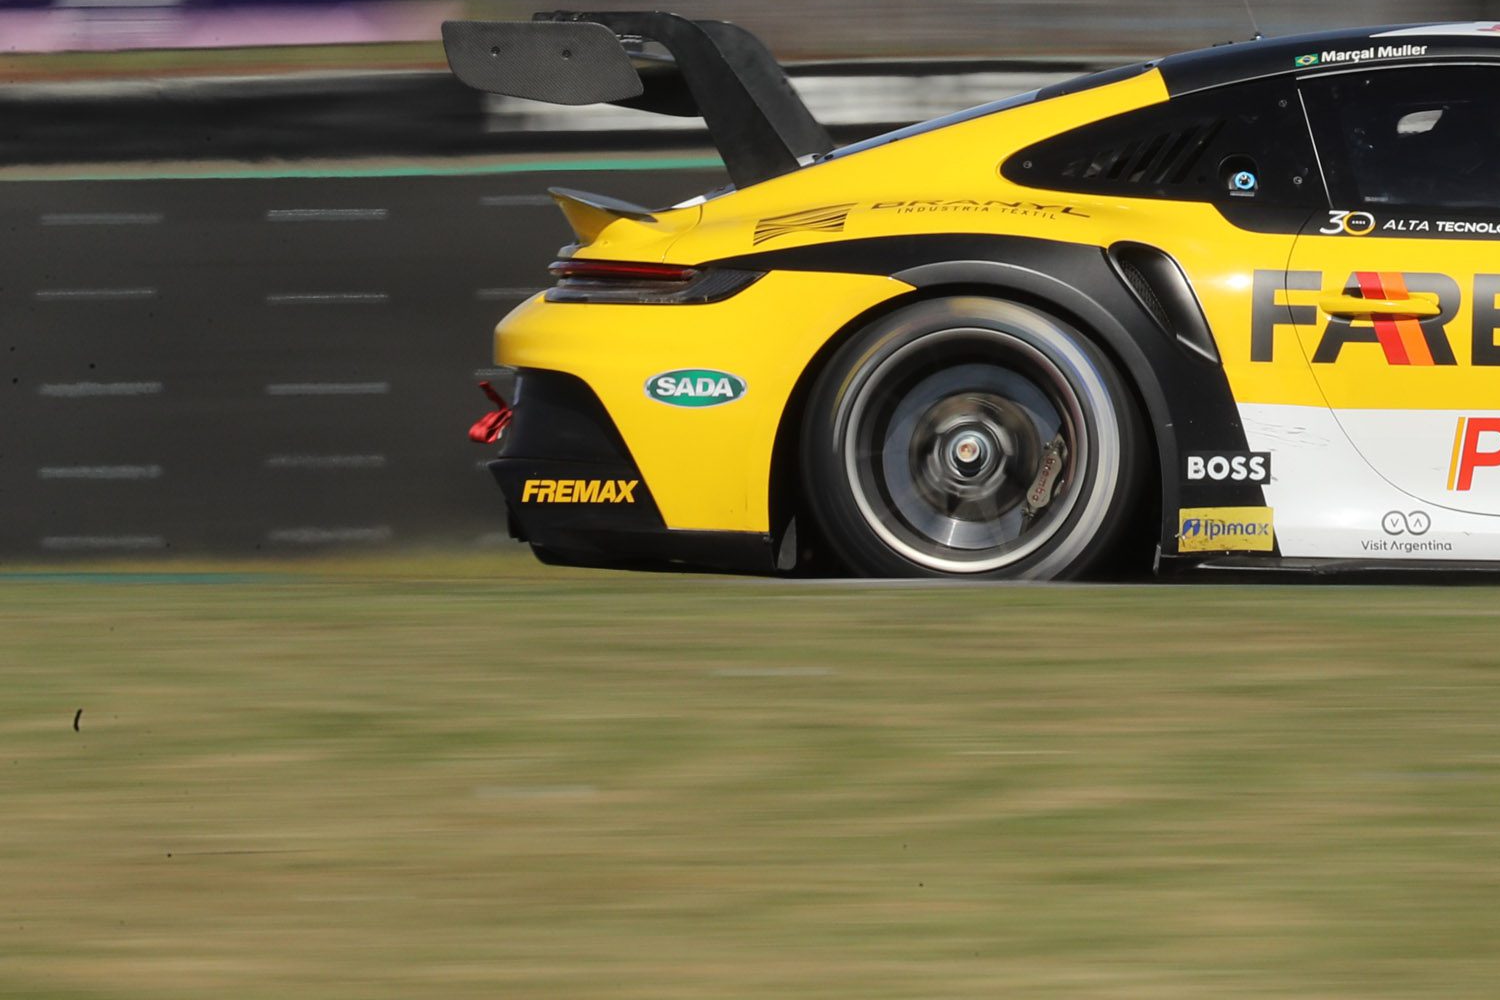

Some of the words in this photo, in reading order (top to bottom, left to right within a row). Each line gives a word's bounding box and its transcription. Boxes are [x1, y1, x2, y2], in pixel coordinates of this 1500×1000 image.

[1320, 47, 1375, 63] Marçal
[1377, 43, 1428, 58] Muller
[1319, 210, 1376, 236] 30
[1382, 219, 1429, 232] ALTA
[656, 376, 733, 397] SADA
[1187, 456, 1266, 481] BOSS
[521, 479, 639, 503] FREMAX
[1361, 539, 1388, 551] Visit
[1390, 539, 1453, 553] Argentina
